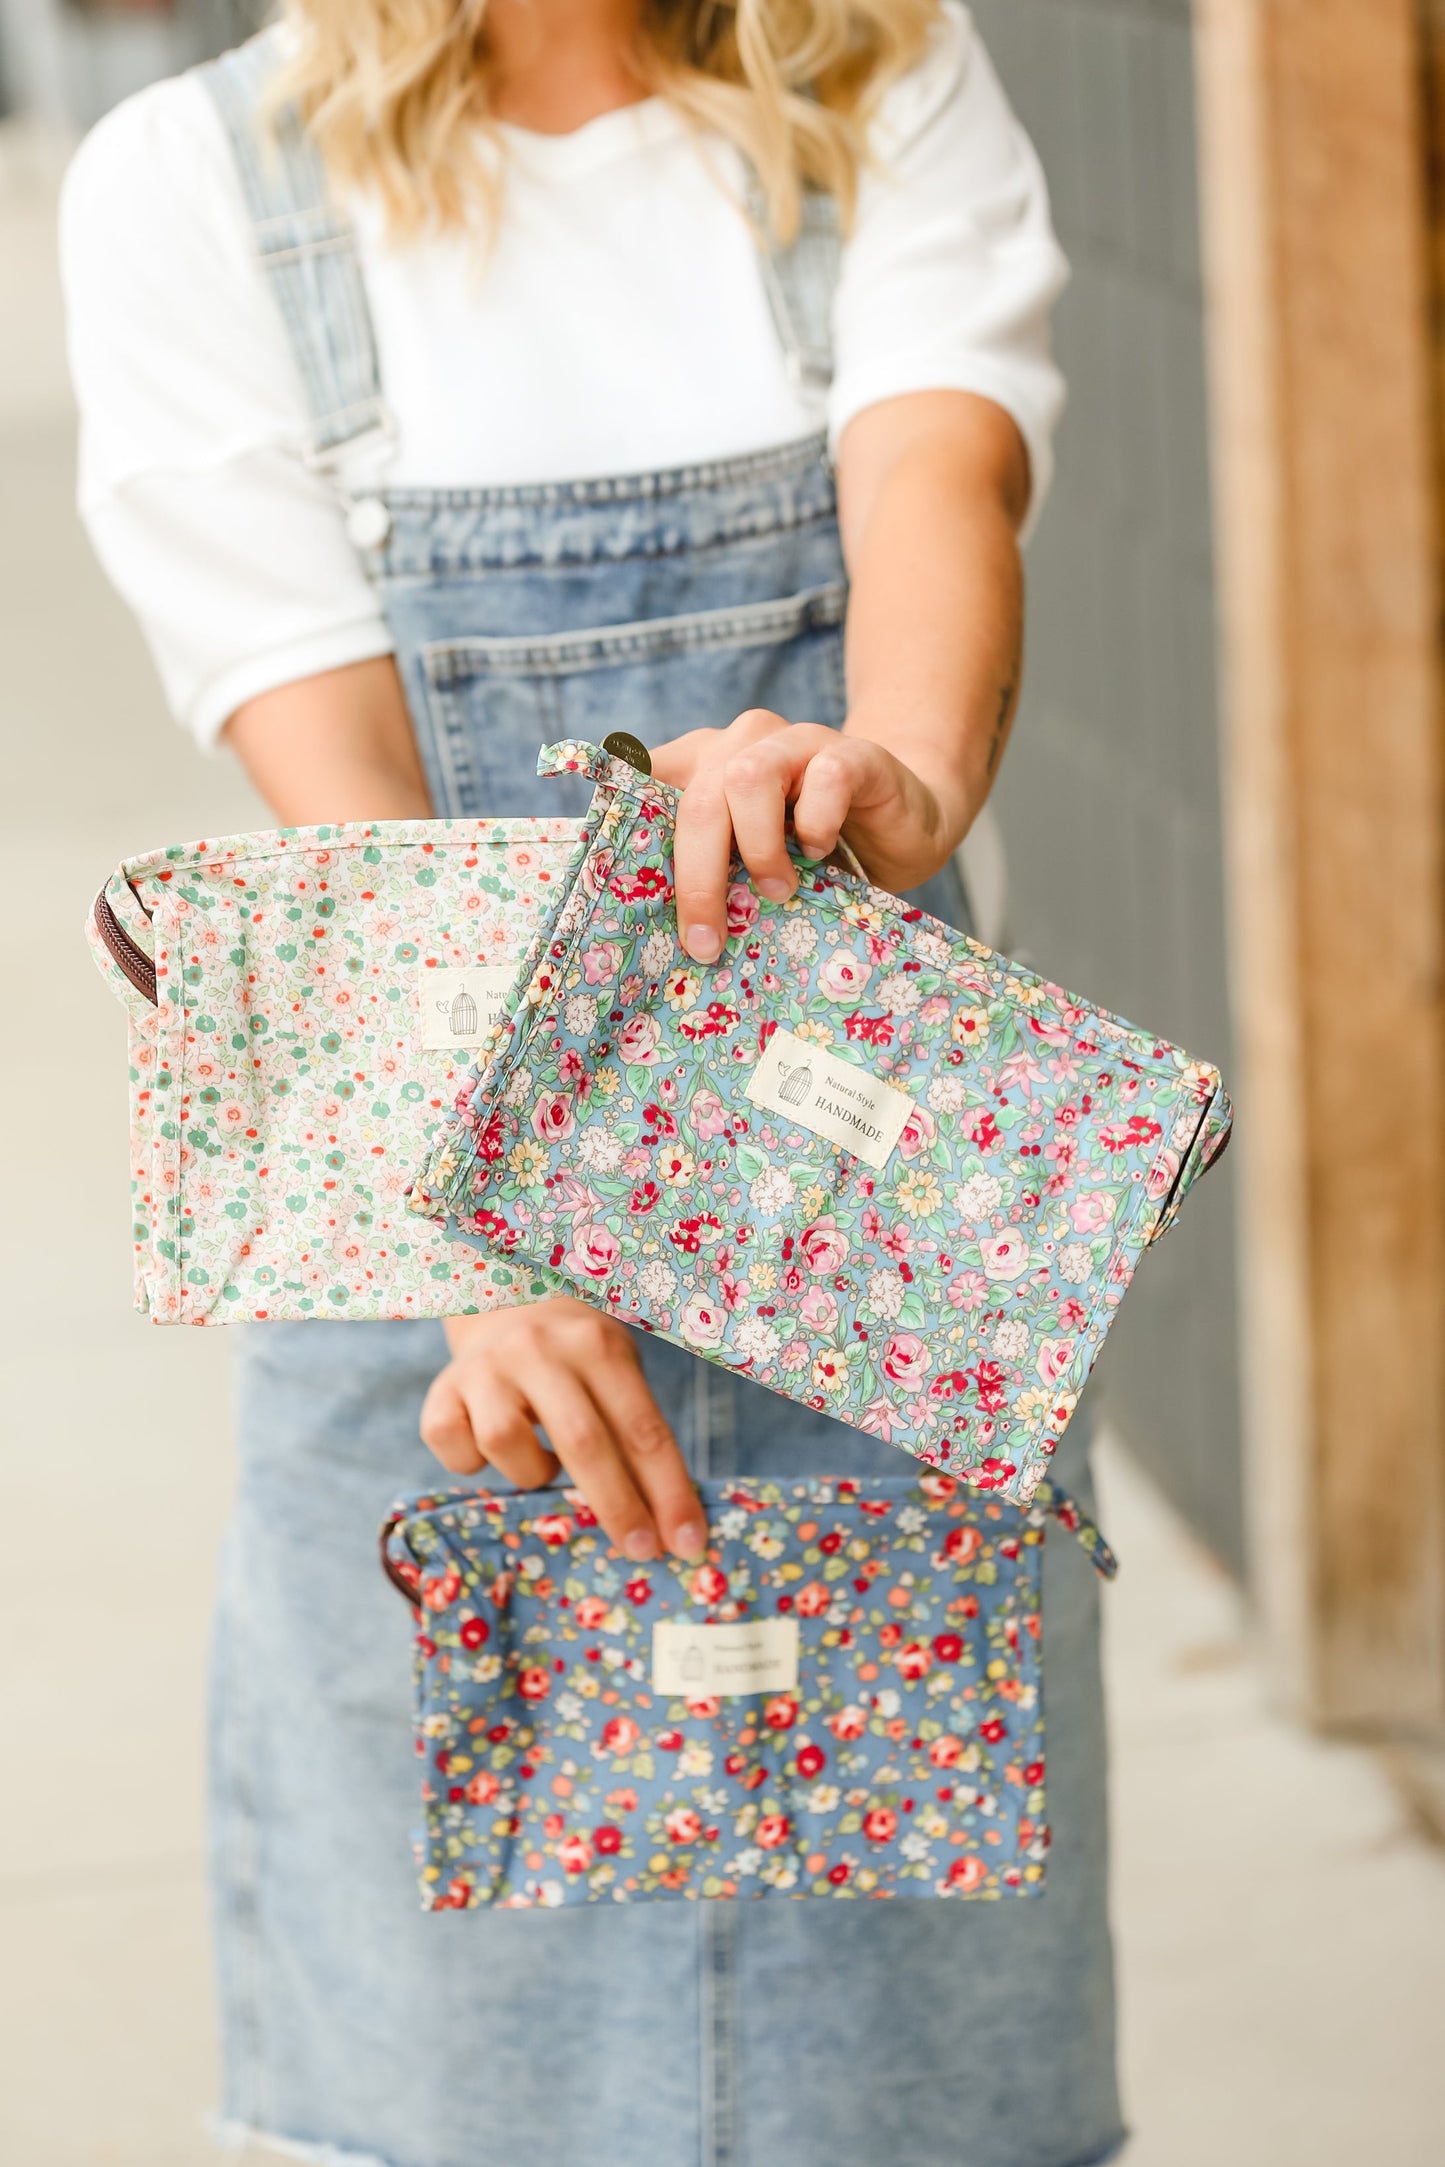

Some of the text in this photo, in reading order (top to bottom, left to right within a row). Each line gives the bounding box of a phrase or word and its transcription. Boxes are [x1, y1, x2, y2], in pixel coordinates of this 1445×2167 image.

[486, 990, 507, 999] Natu
[825, 1076, 876, 1110] Natural Style
[815, 1096, 884, 1143] HANDMADE
